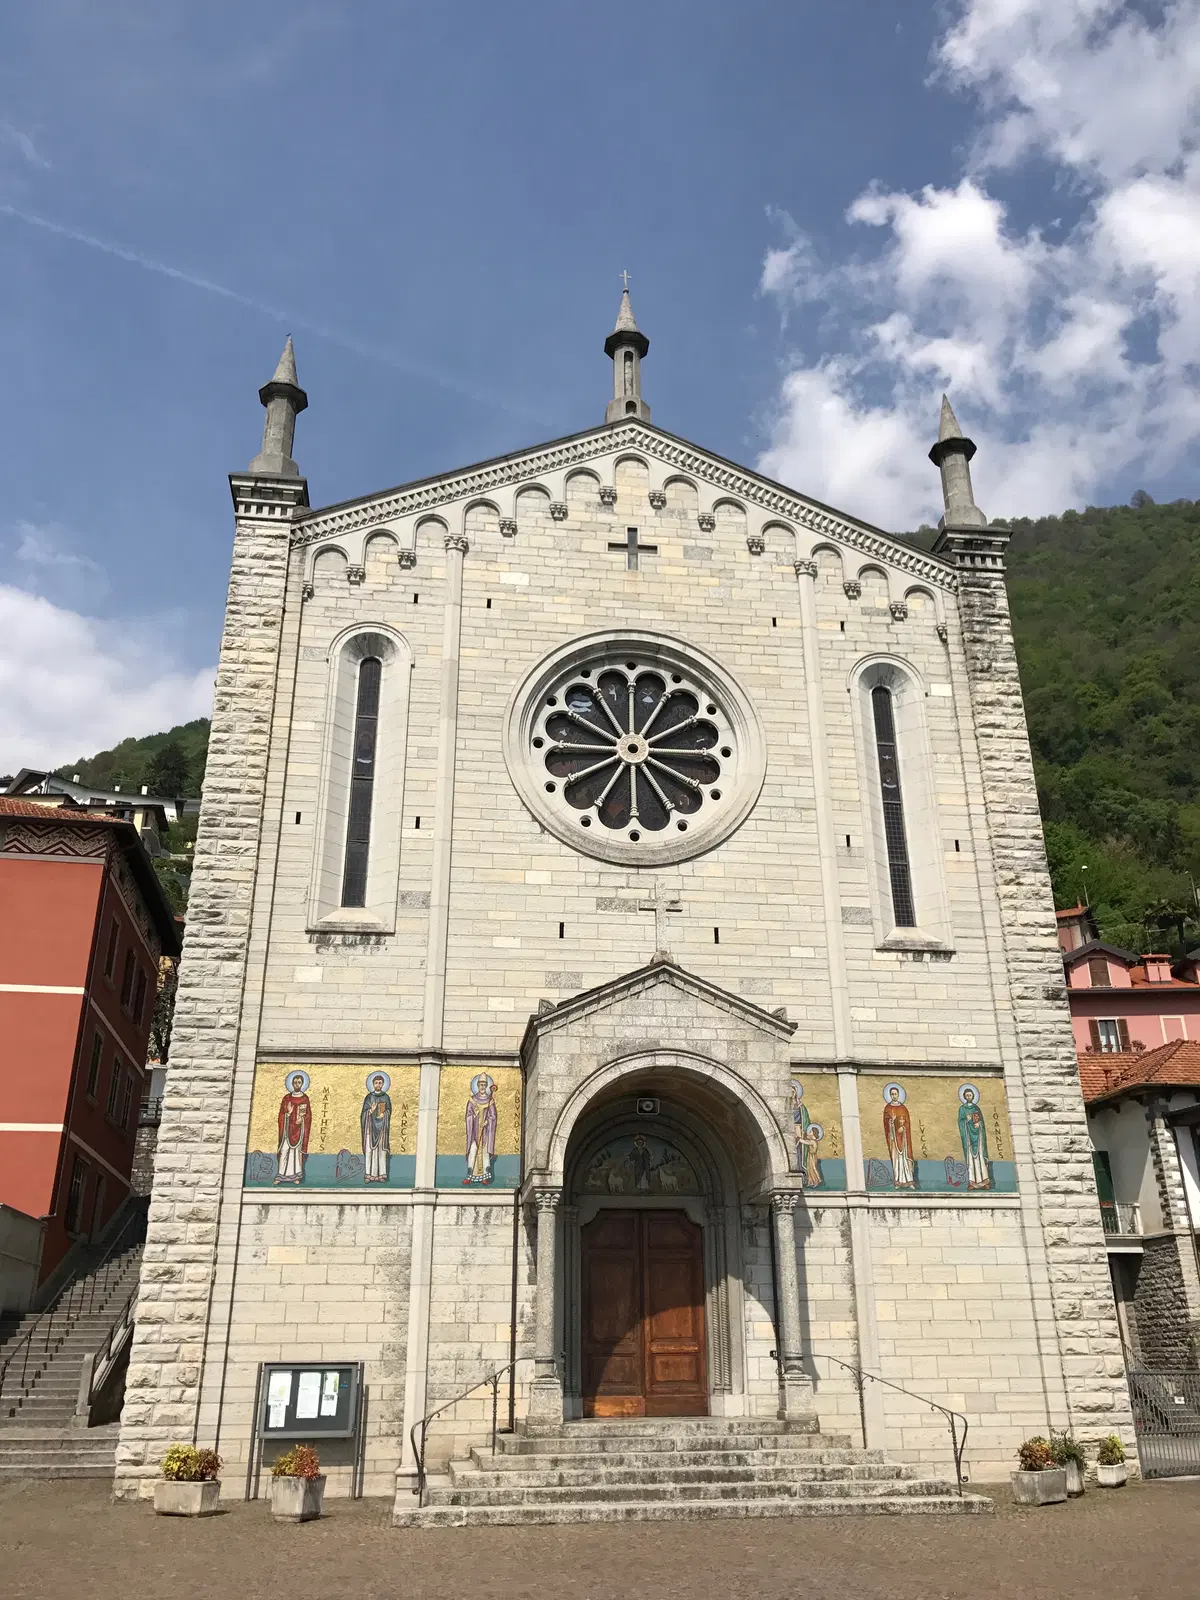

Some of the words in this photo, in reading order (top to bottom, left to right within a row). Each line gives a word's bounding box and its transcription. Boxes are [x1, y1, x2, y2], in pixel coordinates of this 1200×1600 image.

[319, 1086, 330, 1152] MATTHEVS
[400, 1103, 409, 1153] MARCVS
[918, 1119, 928, 1159] LVCAS
[992, 1106, 1004, 1159] IOANNES
